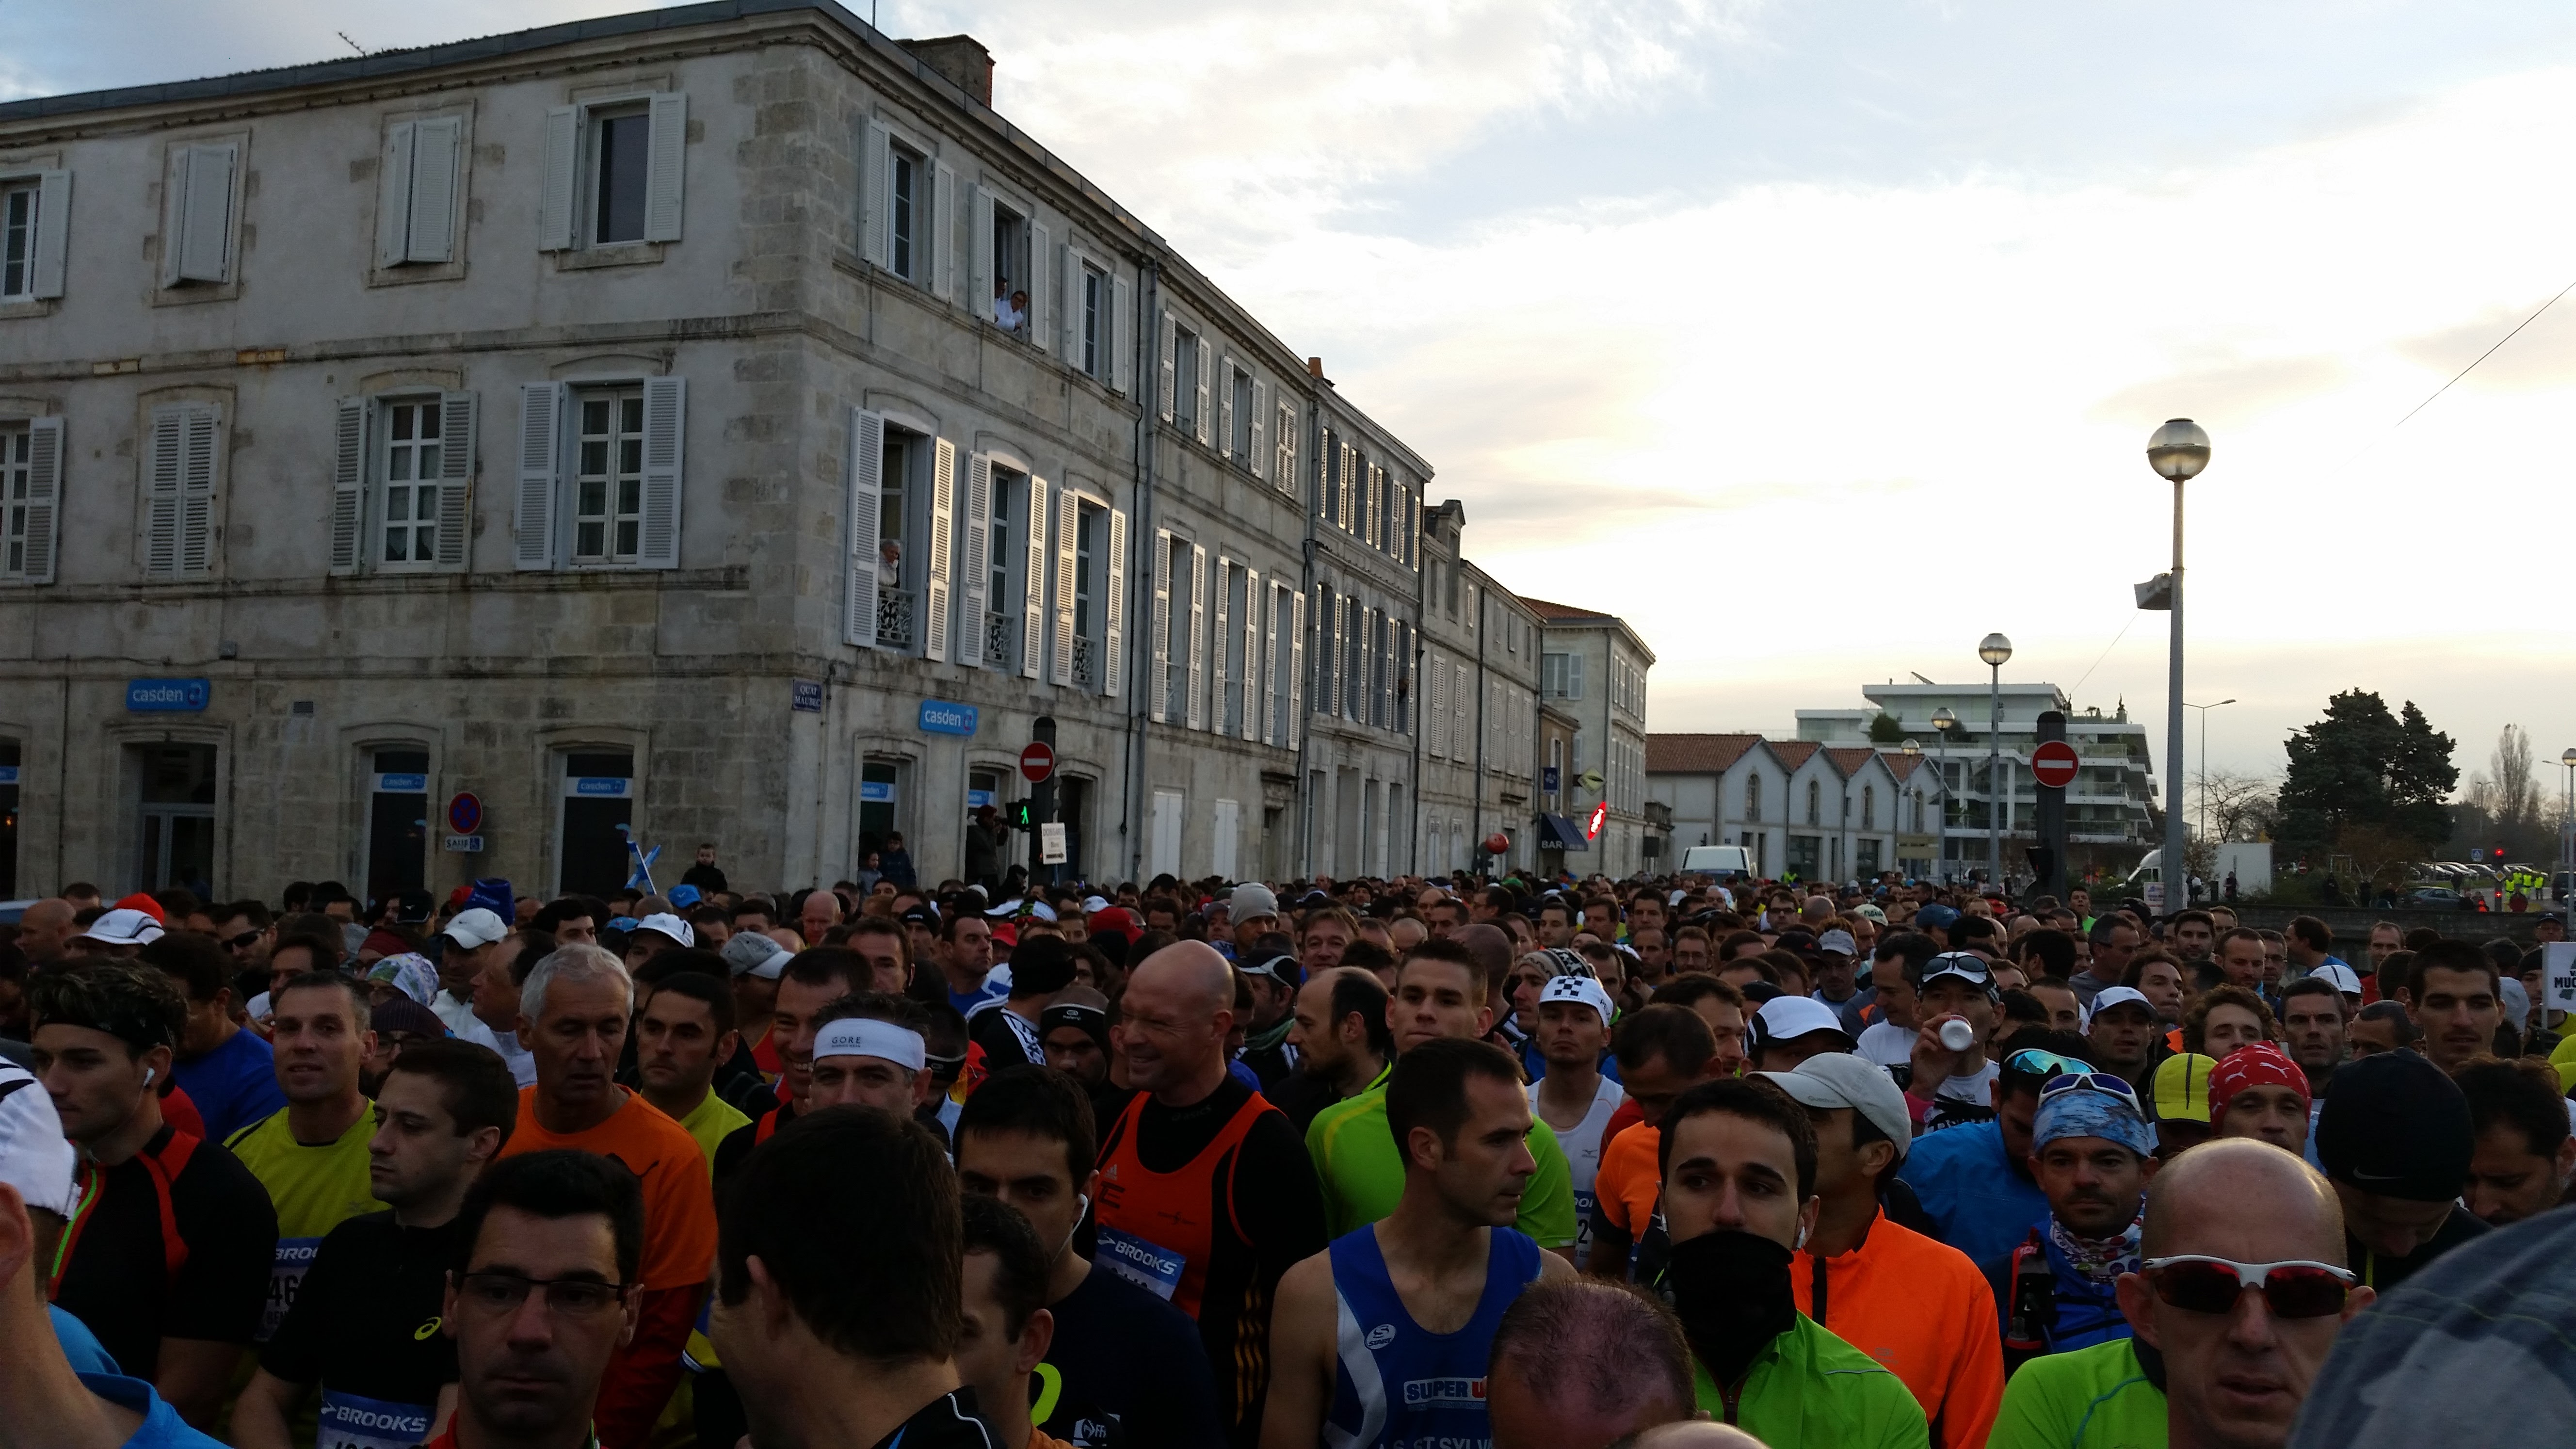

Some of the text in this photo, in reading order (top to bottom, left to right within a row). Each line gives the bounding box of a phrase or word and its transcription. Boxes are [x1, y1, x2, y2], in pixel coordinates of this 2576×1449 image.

[133, 686, 183, 702] casden
[800, 685, 817, 695] QUAI
[795, 695, 820, 706] MAUBEC
[925, 709, 961, 726] casden
[581, 781, 611, 790] casden
[447, 839, 467, 849] SAUF
[1542, 840, 1563, 849] BAR
[1115, 1240, 1177, 1275] BROOKS
[1407, 1381, 1486, 1401] SUPER U
[337, 1406, 427, 1433] BROOKS
